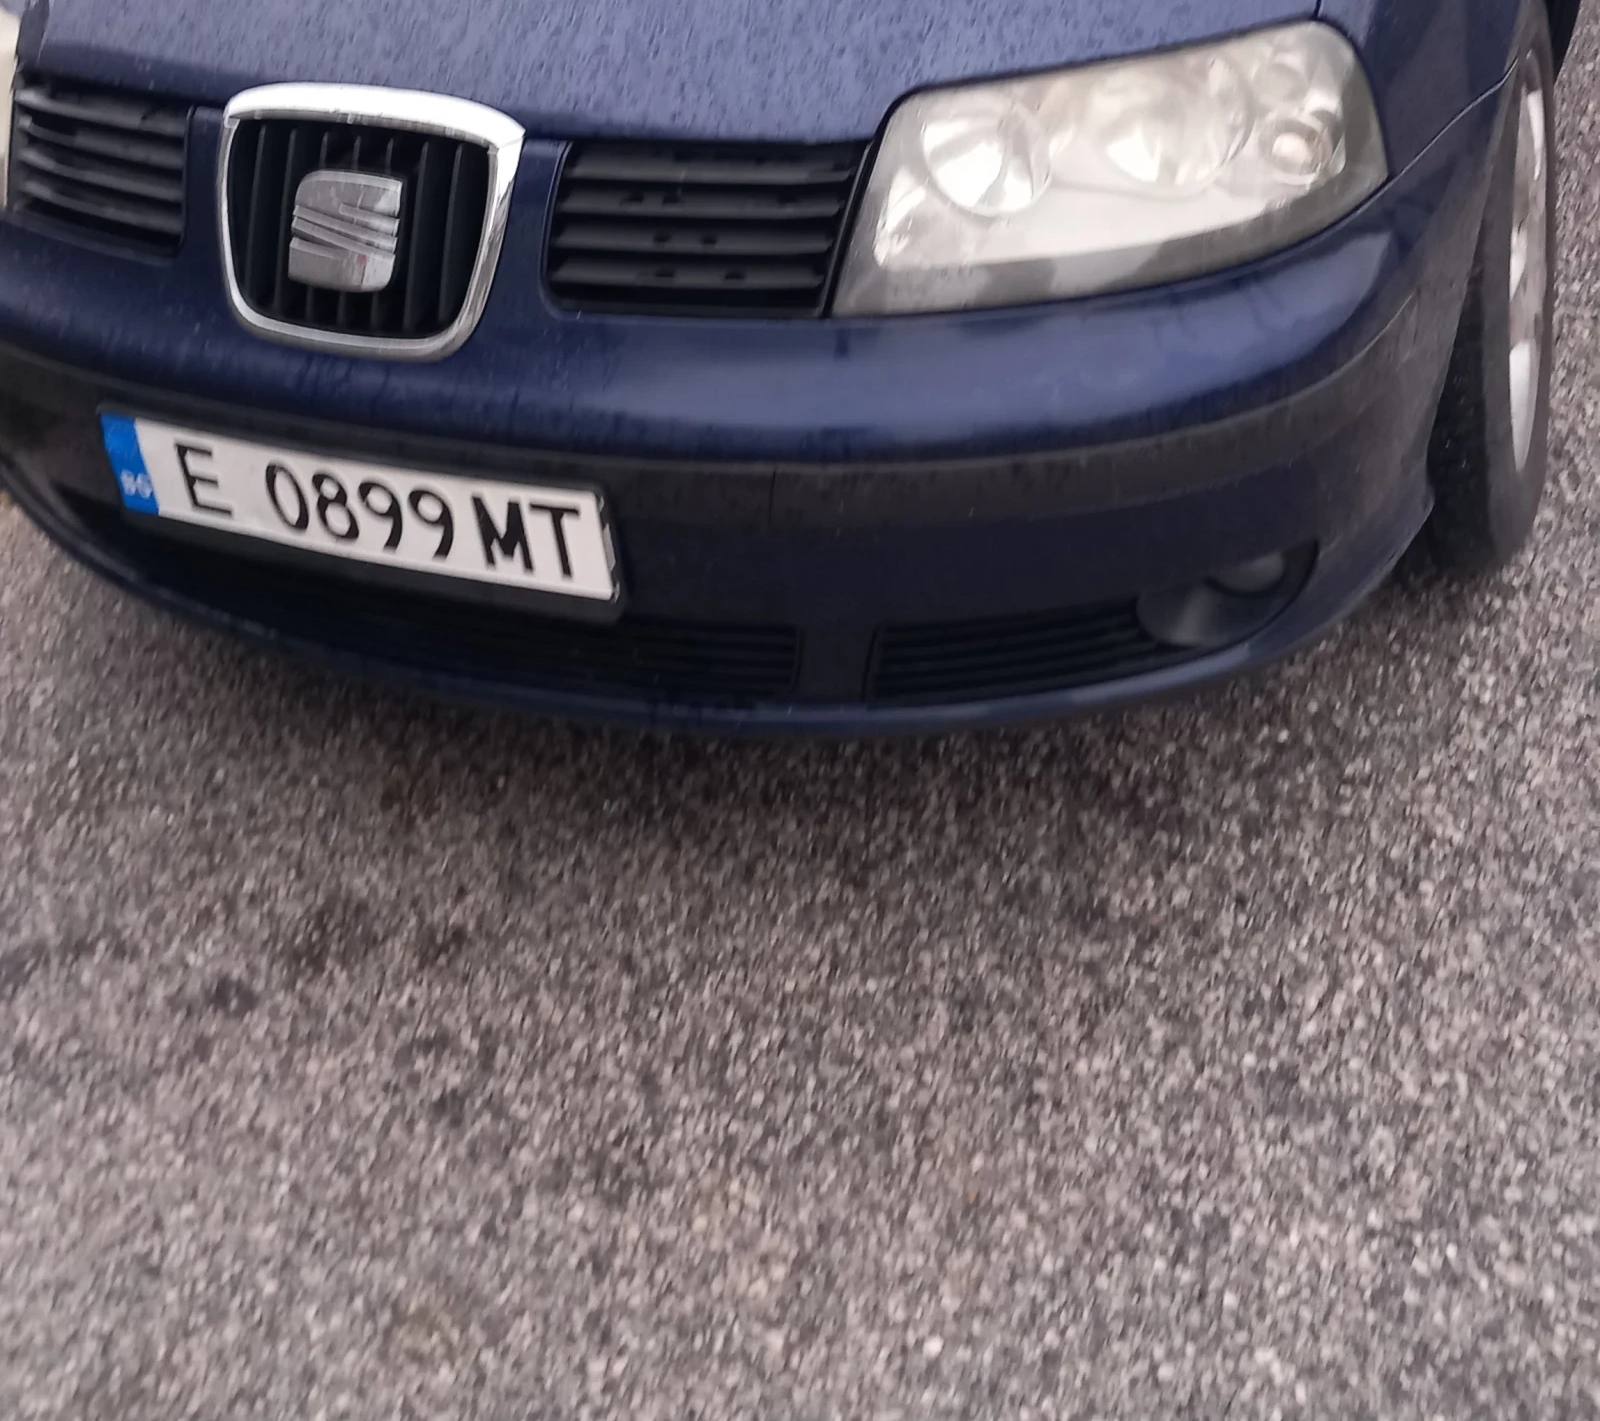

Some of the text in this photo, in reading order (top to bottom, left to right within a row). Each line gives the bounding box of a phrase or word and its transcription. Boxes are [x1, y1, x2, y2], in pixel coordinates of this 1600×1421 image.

[174, 442, 580, 578] E 0899 MT
